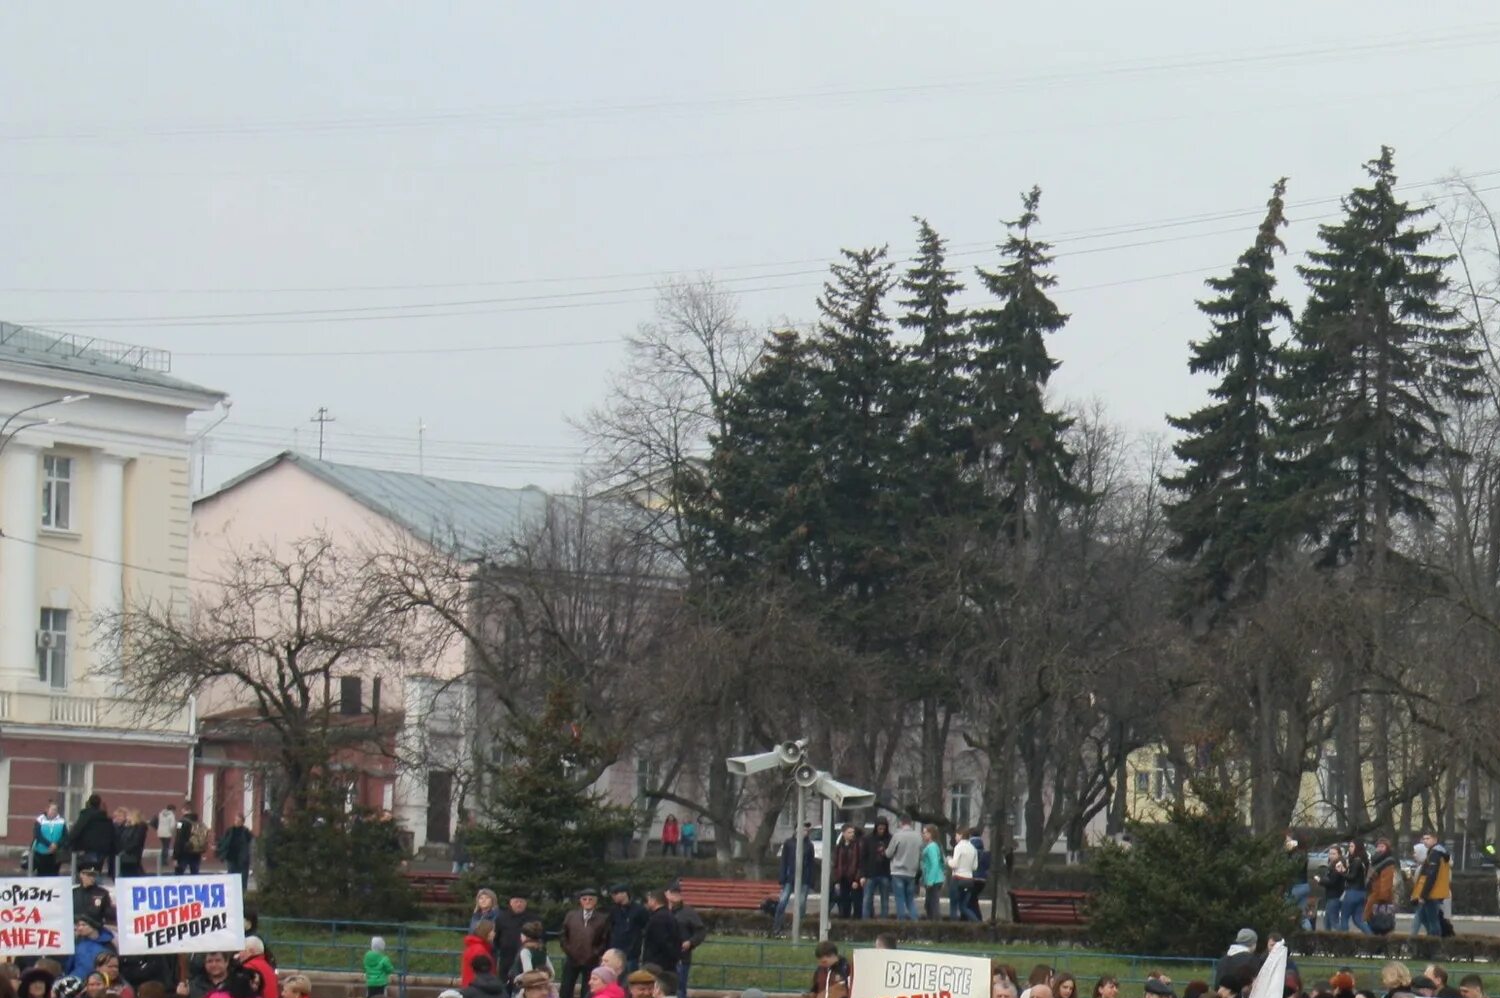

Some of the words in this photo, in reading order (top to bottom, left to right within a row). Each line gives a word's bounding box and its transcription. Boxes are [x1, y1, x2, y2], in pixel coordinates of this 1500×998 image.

[132, 884, 226, 911] РОССИЯ
[134, 902, 202, 935] ПРОТИВ
[144, 912, 228, 949] ТЕРРОРА!
[885, 961, 973, 996] ВМЕСТЕ
